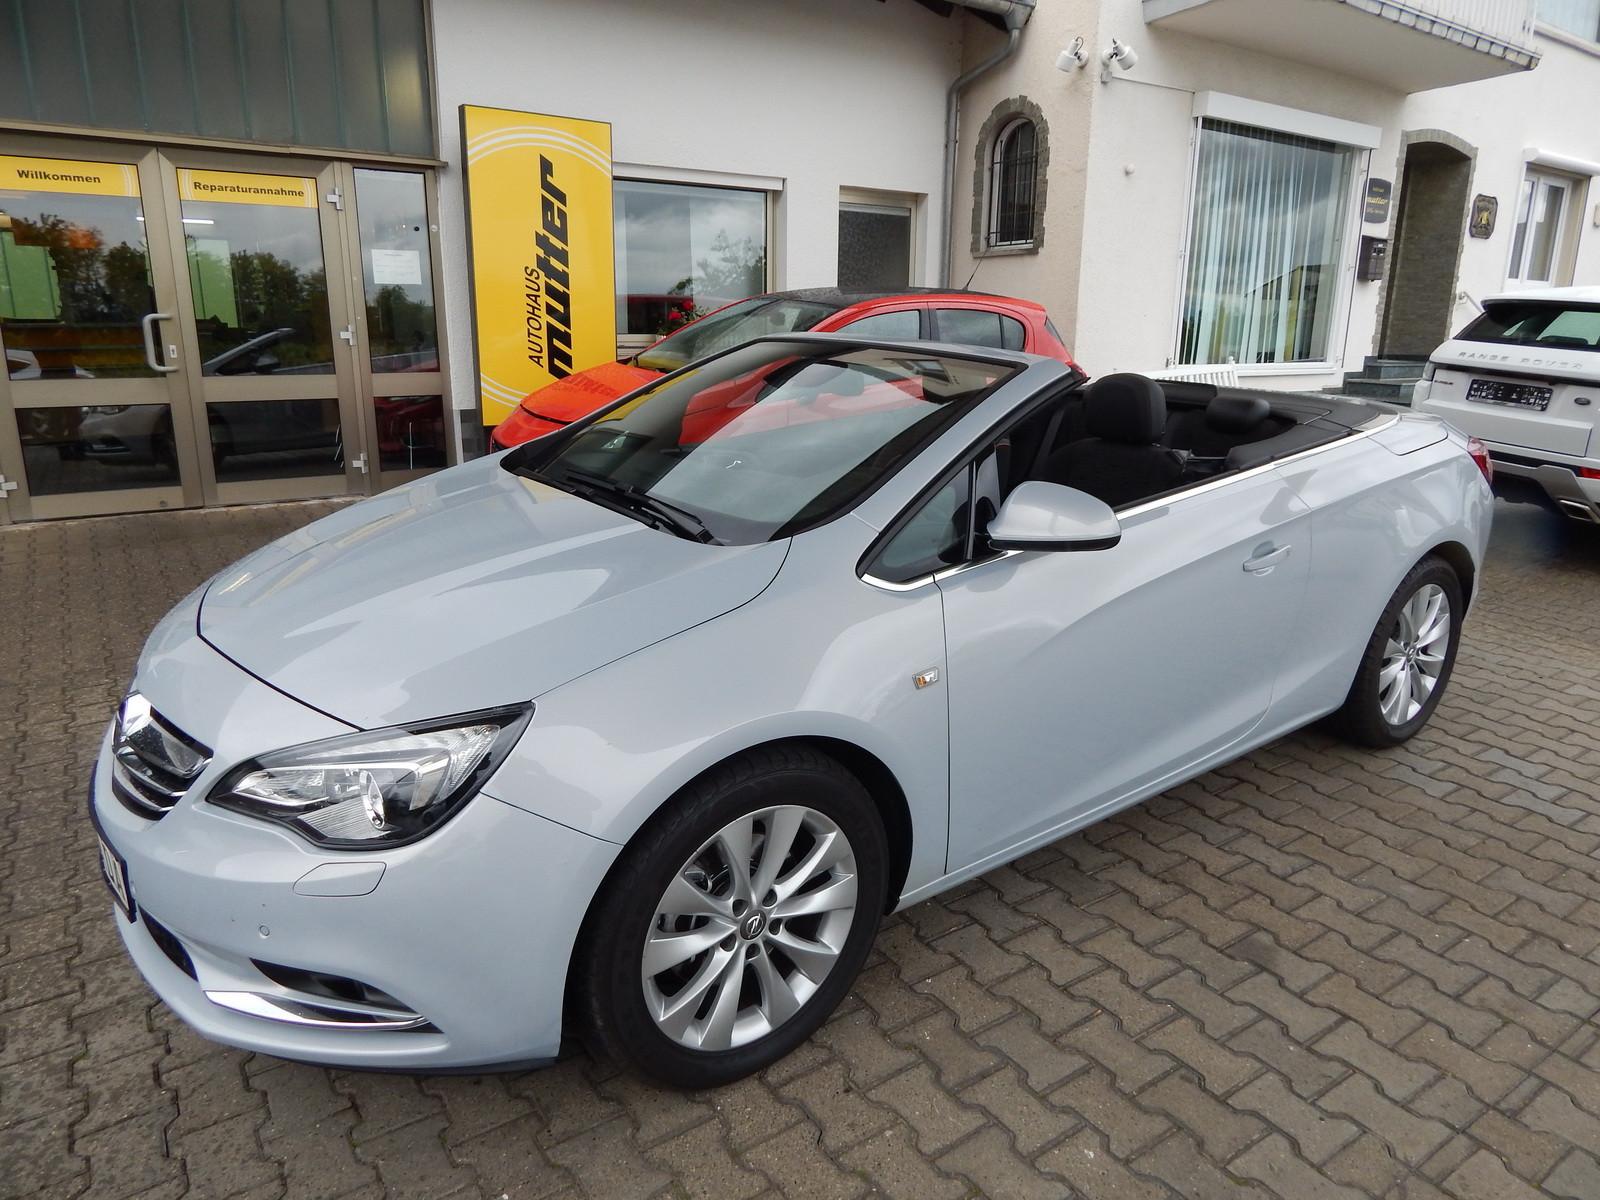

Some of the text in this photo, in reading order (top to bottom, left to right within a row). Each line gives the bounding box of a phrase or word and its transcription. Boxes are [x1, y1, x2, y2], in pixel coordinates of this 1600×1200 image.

[16, 169, 101, 184] Willkommen
[193, 181, 305, 198] Reparaturannahme
[535, 153, 573, 380] mutter
[524, 266, 544, 368] AUTOHAUS
[1458, 351, 1510, 362] RANGE
